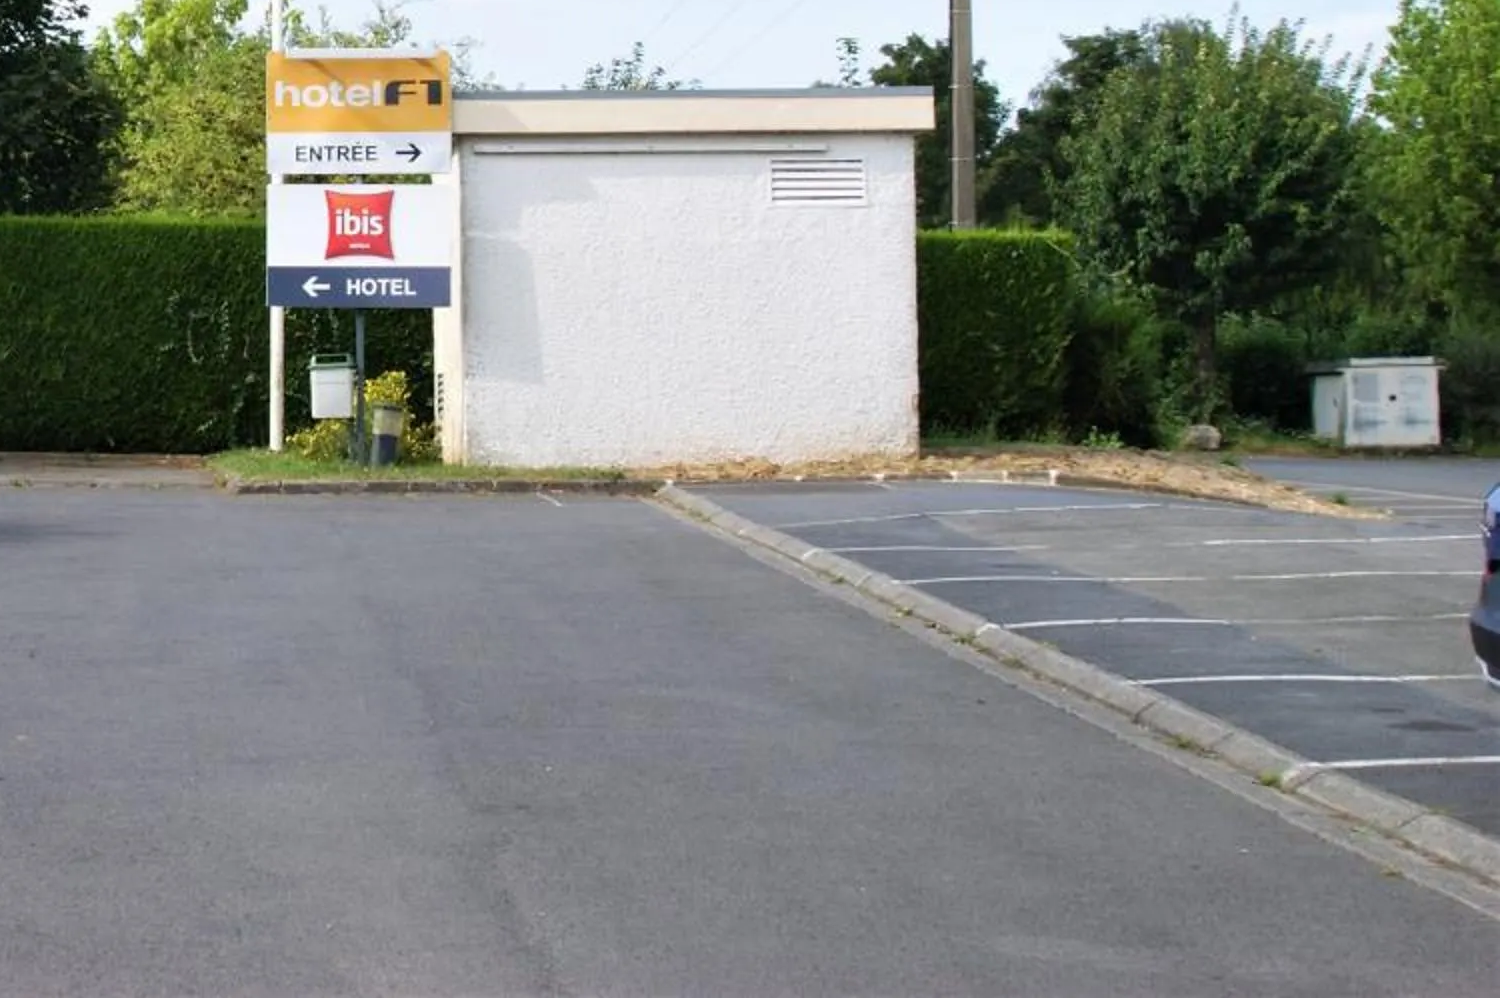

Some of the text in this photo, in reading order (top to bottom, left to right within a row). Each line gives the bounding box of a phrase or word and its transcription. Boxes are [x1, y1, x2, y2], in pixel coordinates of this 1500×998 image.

[295, 141, 378, 162] ENTRÉE
[335, 209, 384, 235] ibis
[346, 278, 417, 296] HOTEL
